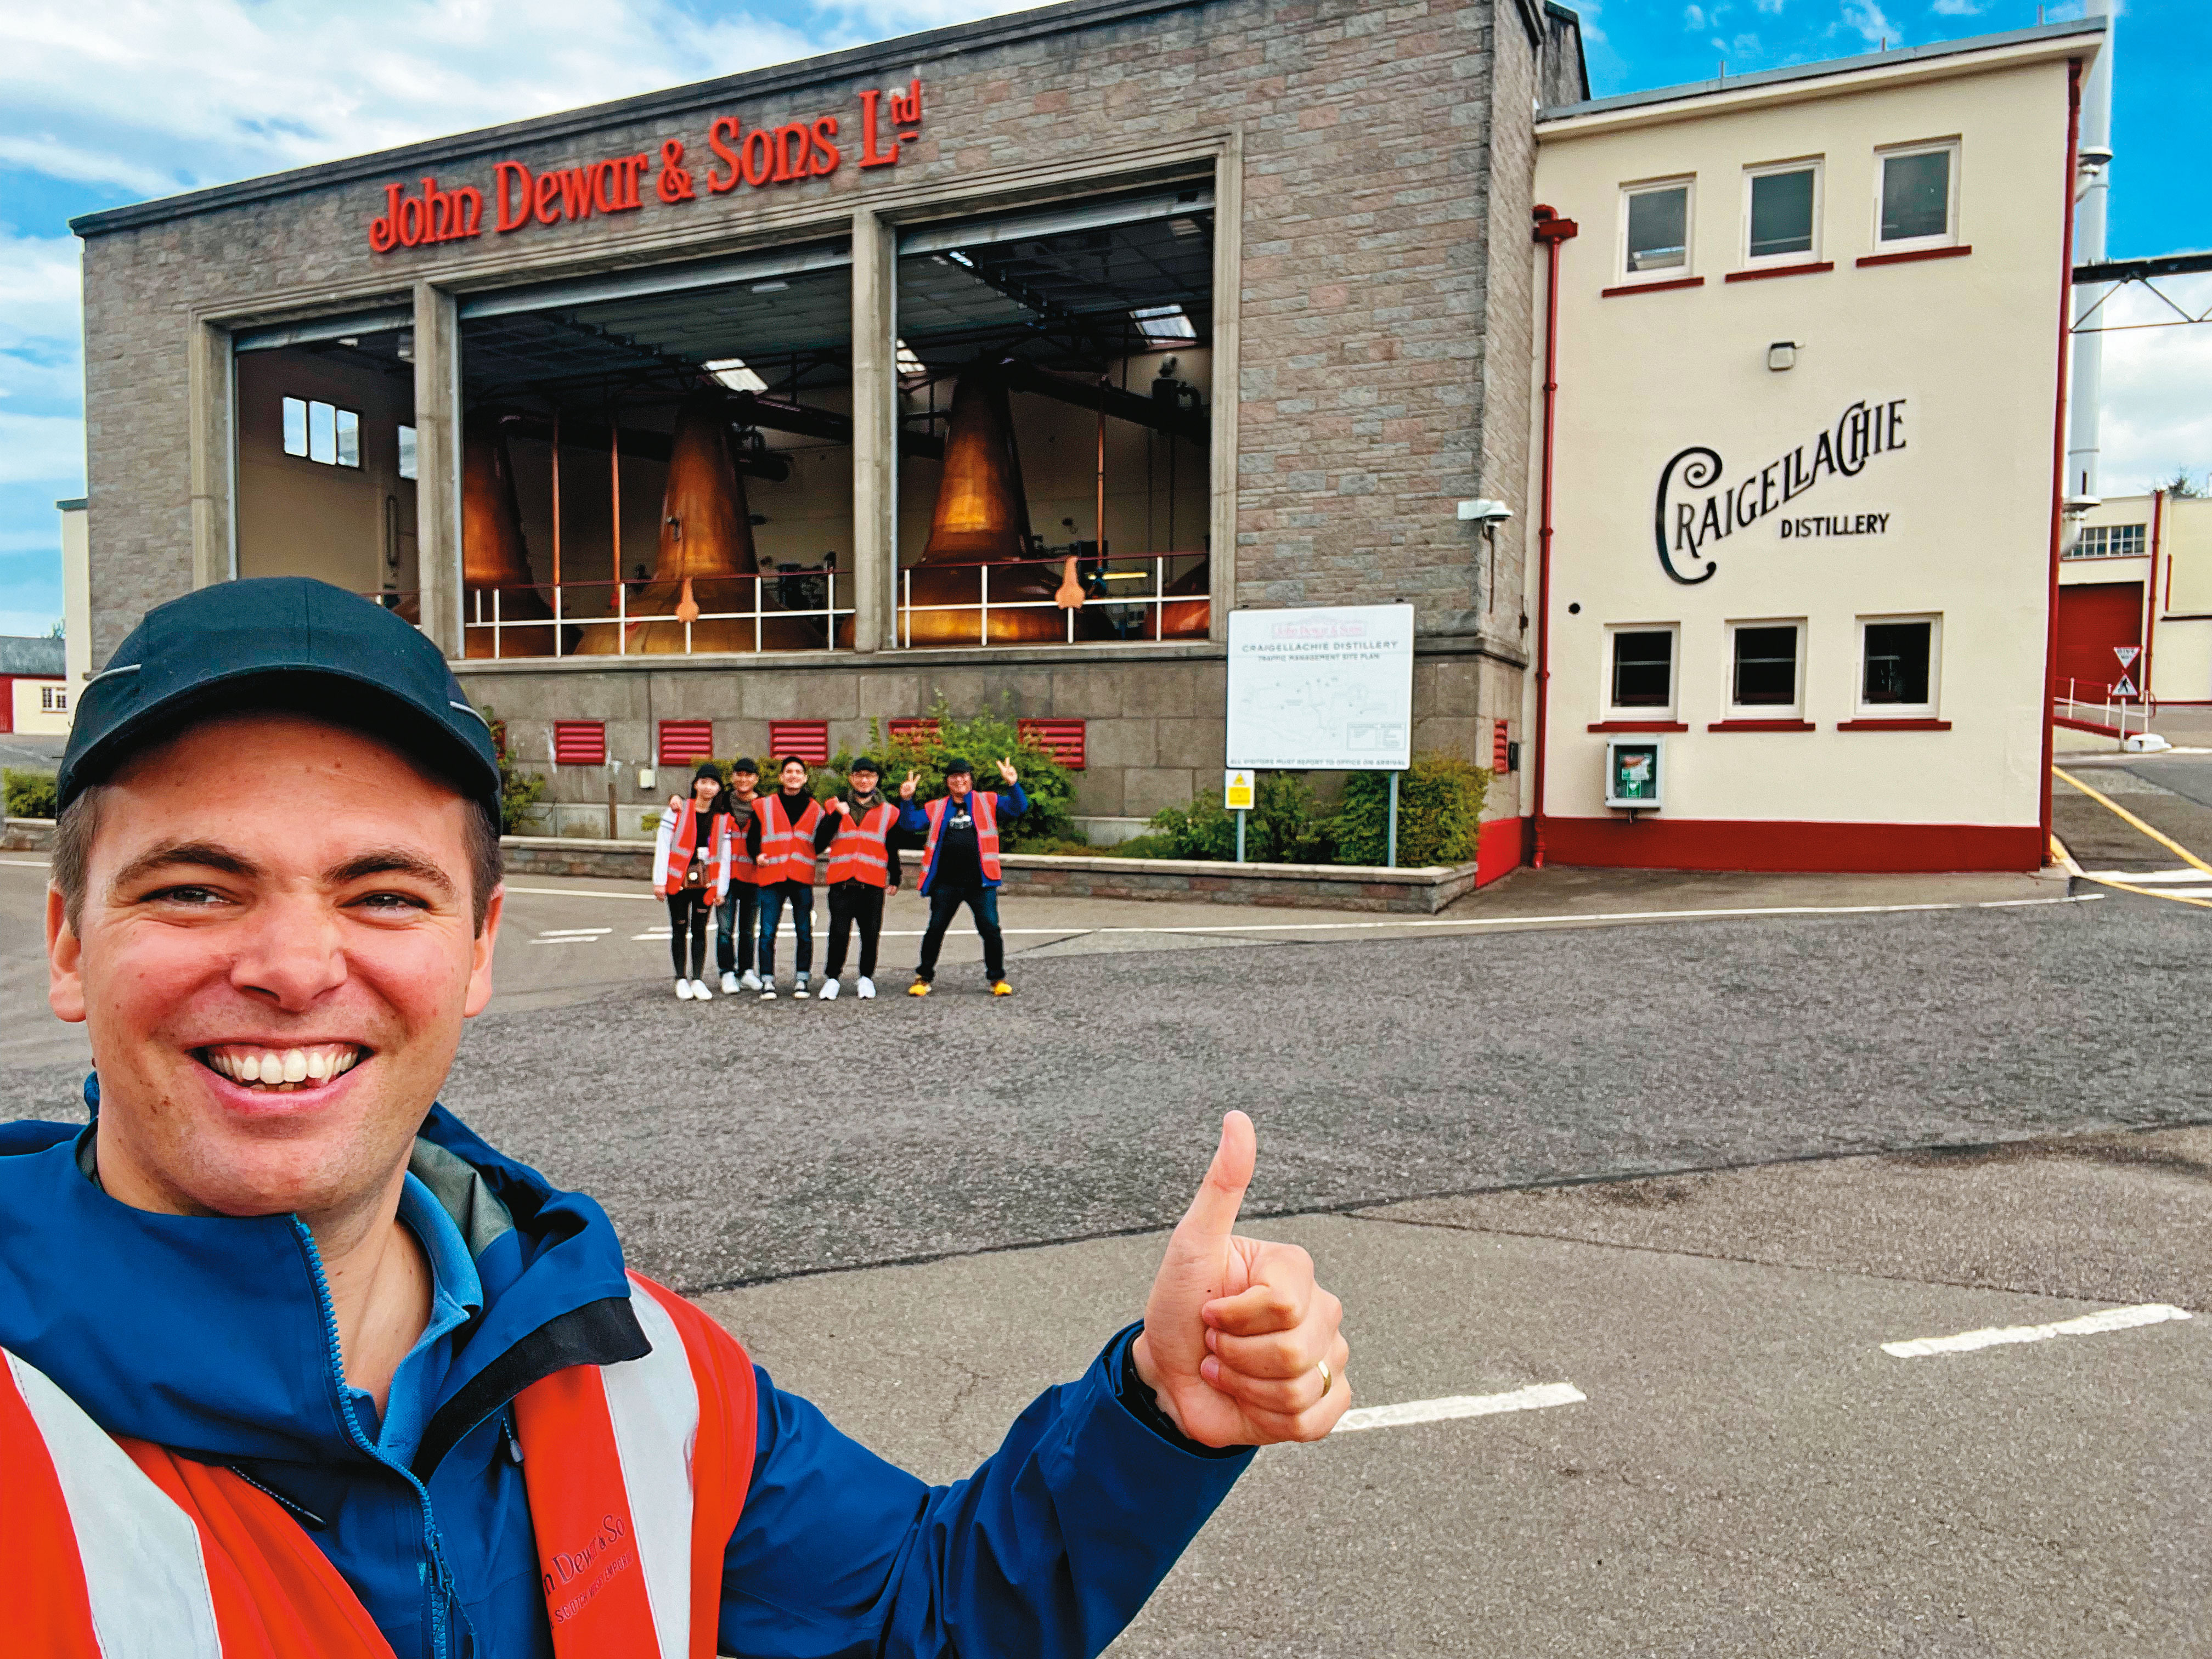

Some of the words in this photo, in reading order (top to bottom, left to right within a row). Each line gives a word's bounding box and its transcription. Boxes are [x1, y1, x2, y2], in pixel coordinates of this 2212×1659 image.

[368, 176, 484, 253] John
[492, 152, 649, 233] Dewar
[656, 138, 696, 204] &
[706, 116, 841, 194] Sons
[1654, 399, 1907, 586] CRAIGELLACHIE
[1780, 513, 1891, 539] DISTILLERY
[1242, 642, 1329, 652] CRAIGELLACHIE
[1333, 640, 1398, 650] DISTILLERY
[555, 1595, 588, 1623] SCOTCH
